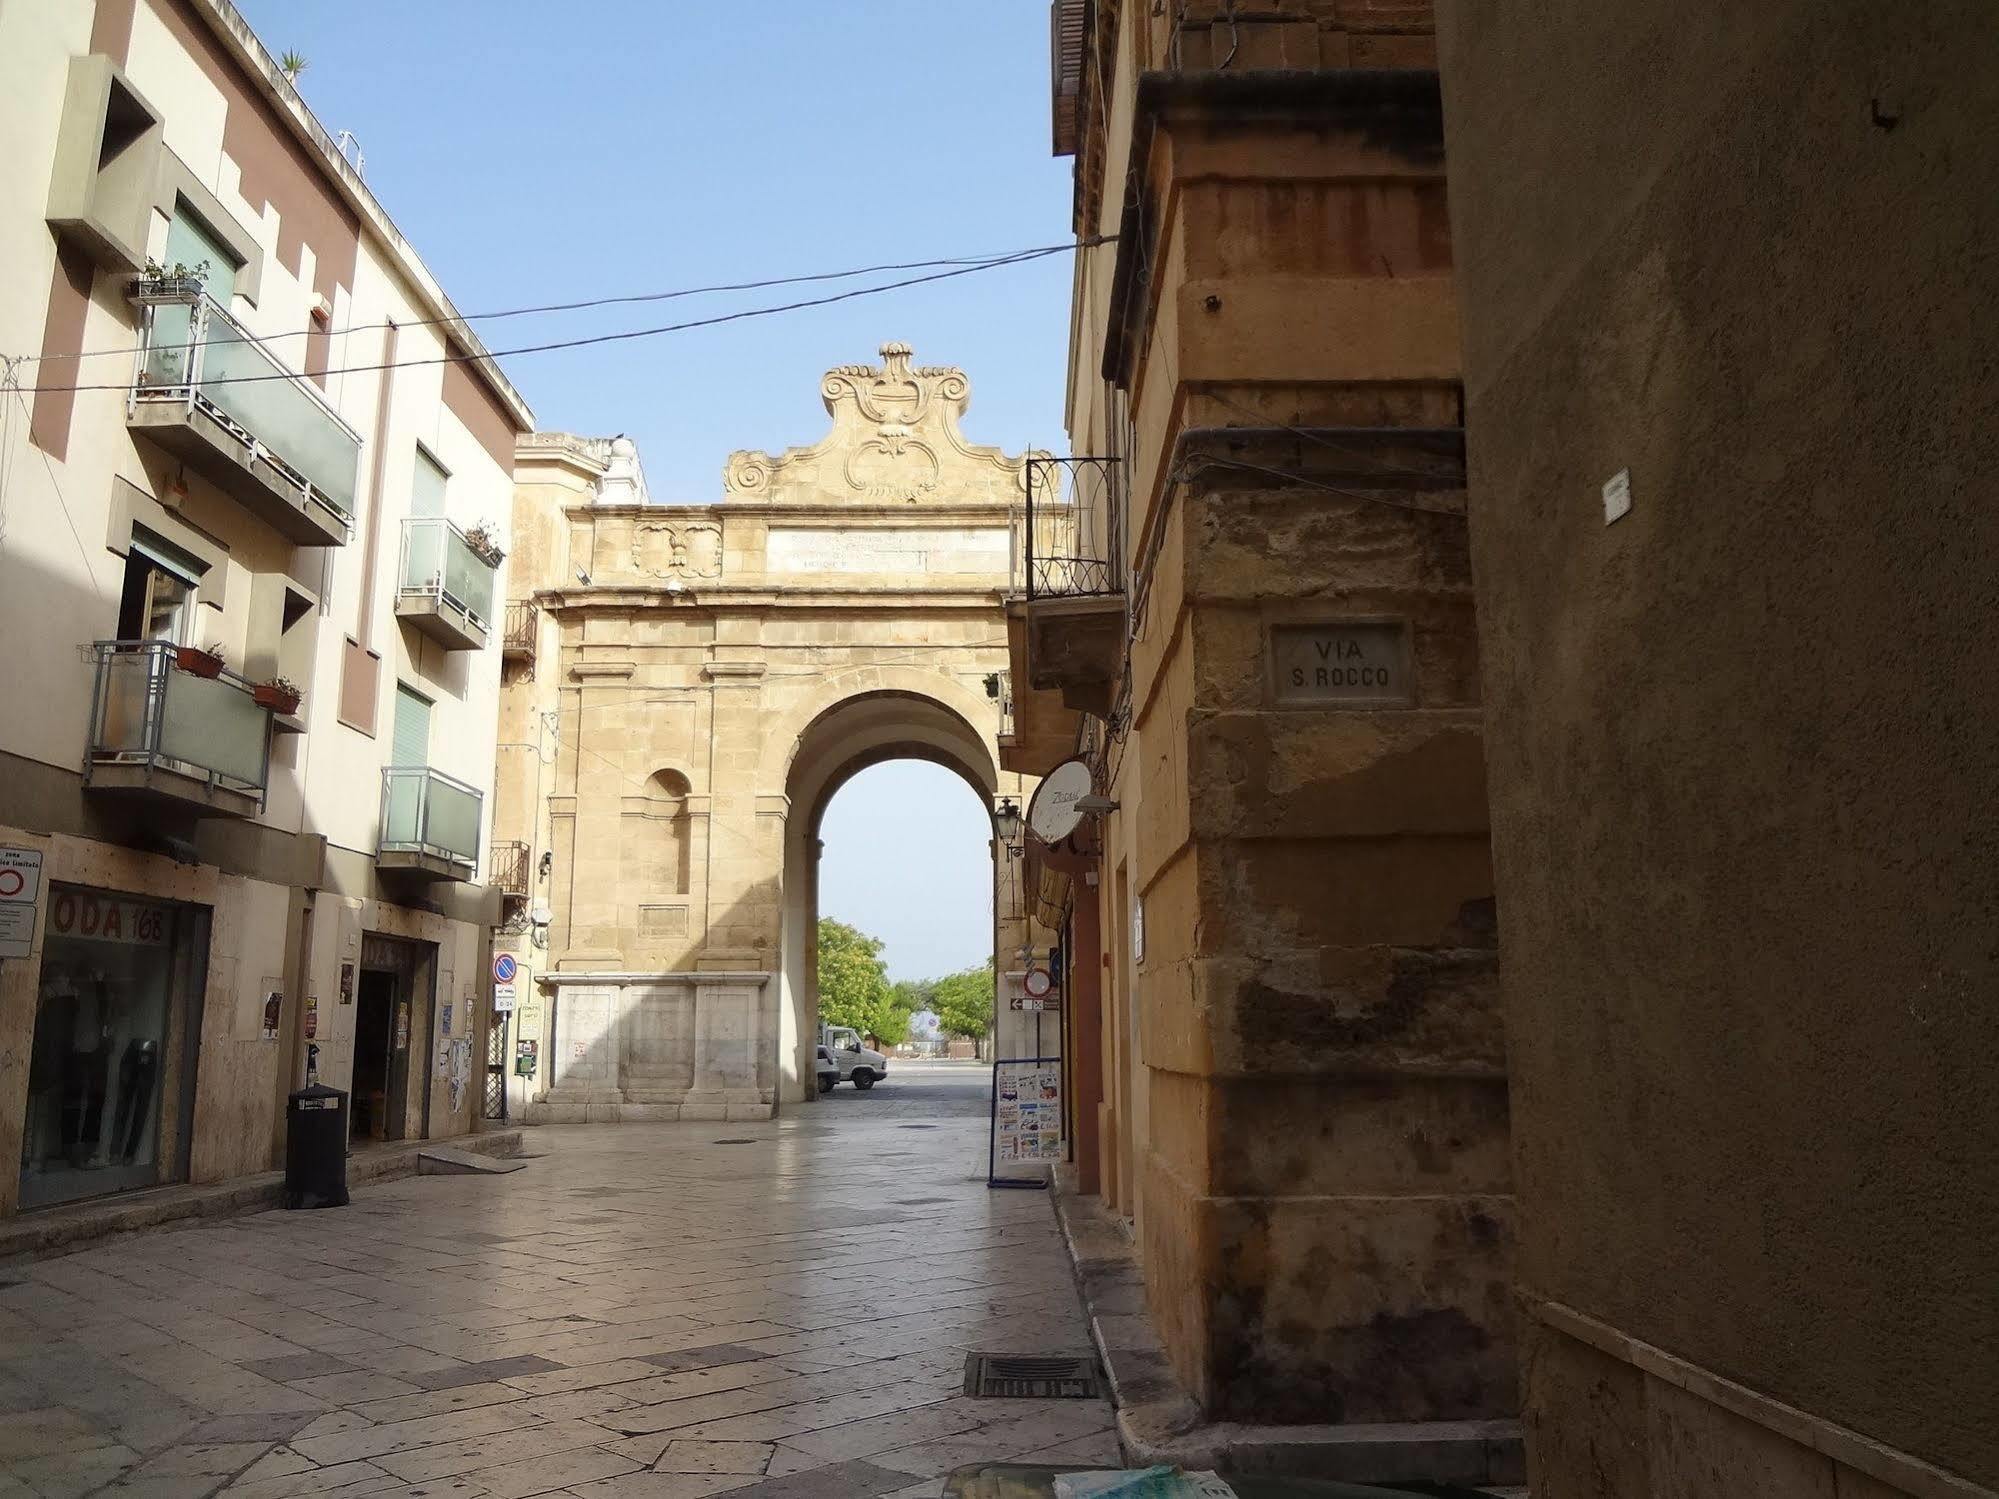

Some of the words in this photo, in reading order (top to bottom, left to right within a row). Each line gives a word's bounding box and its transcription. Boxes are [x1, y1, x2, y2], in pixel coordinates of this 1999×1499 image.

[1315, 639, 1363, 660] VIA
[1292, 667, 1309, 687] S.
[1315, 667, 1389, 687] ROCCO
